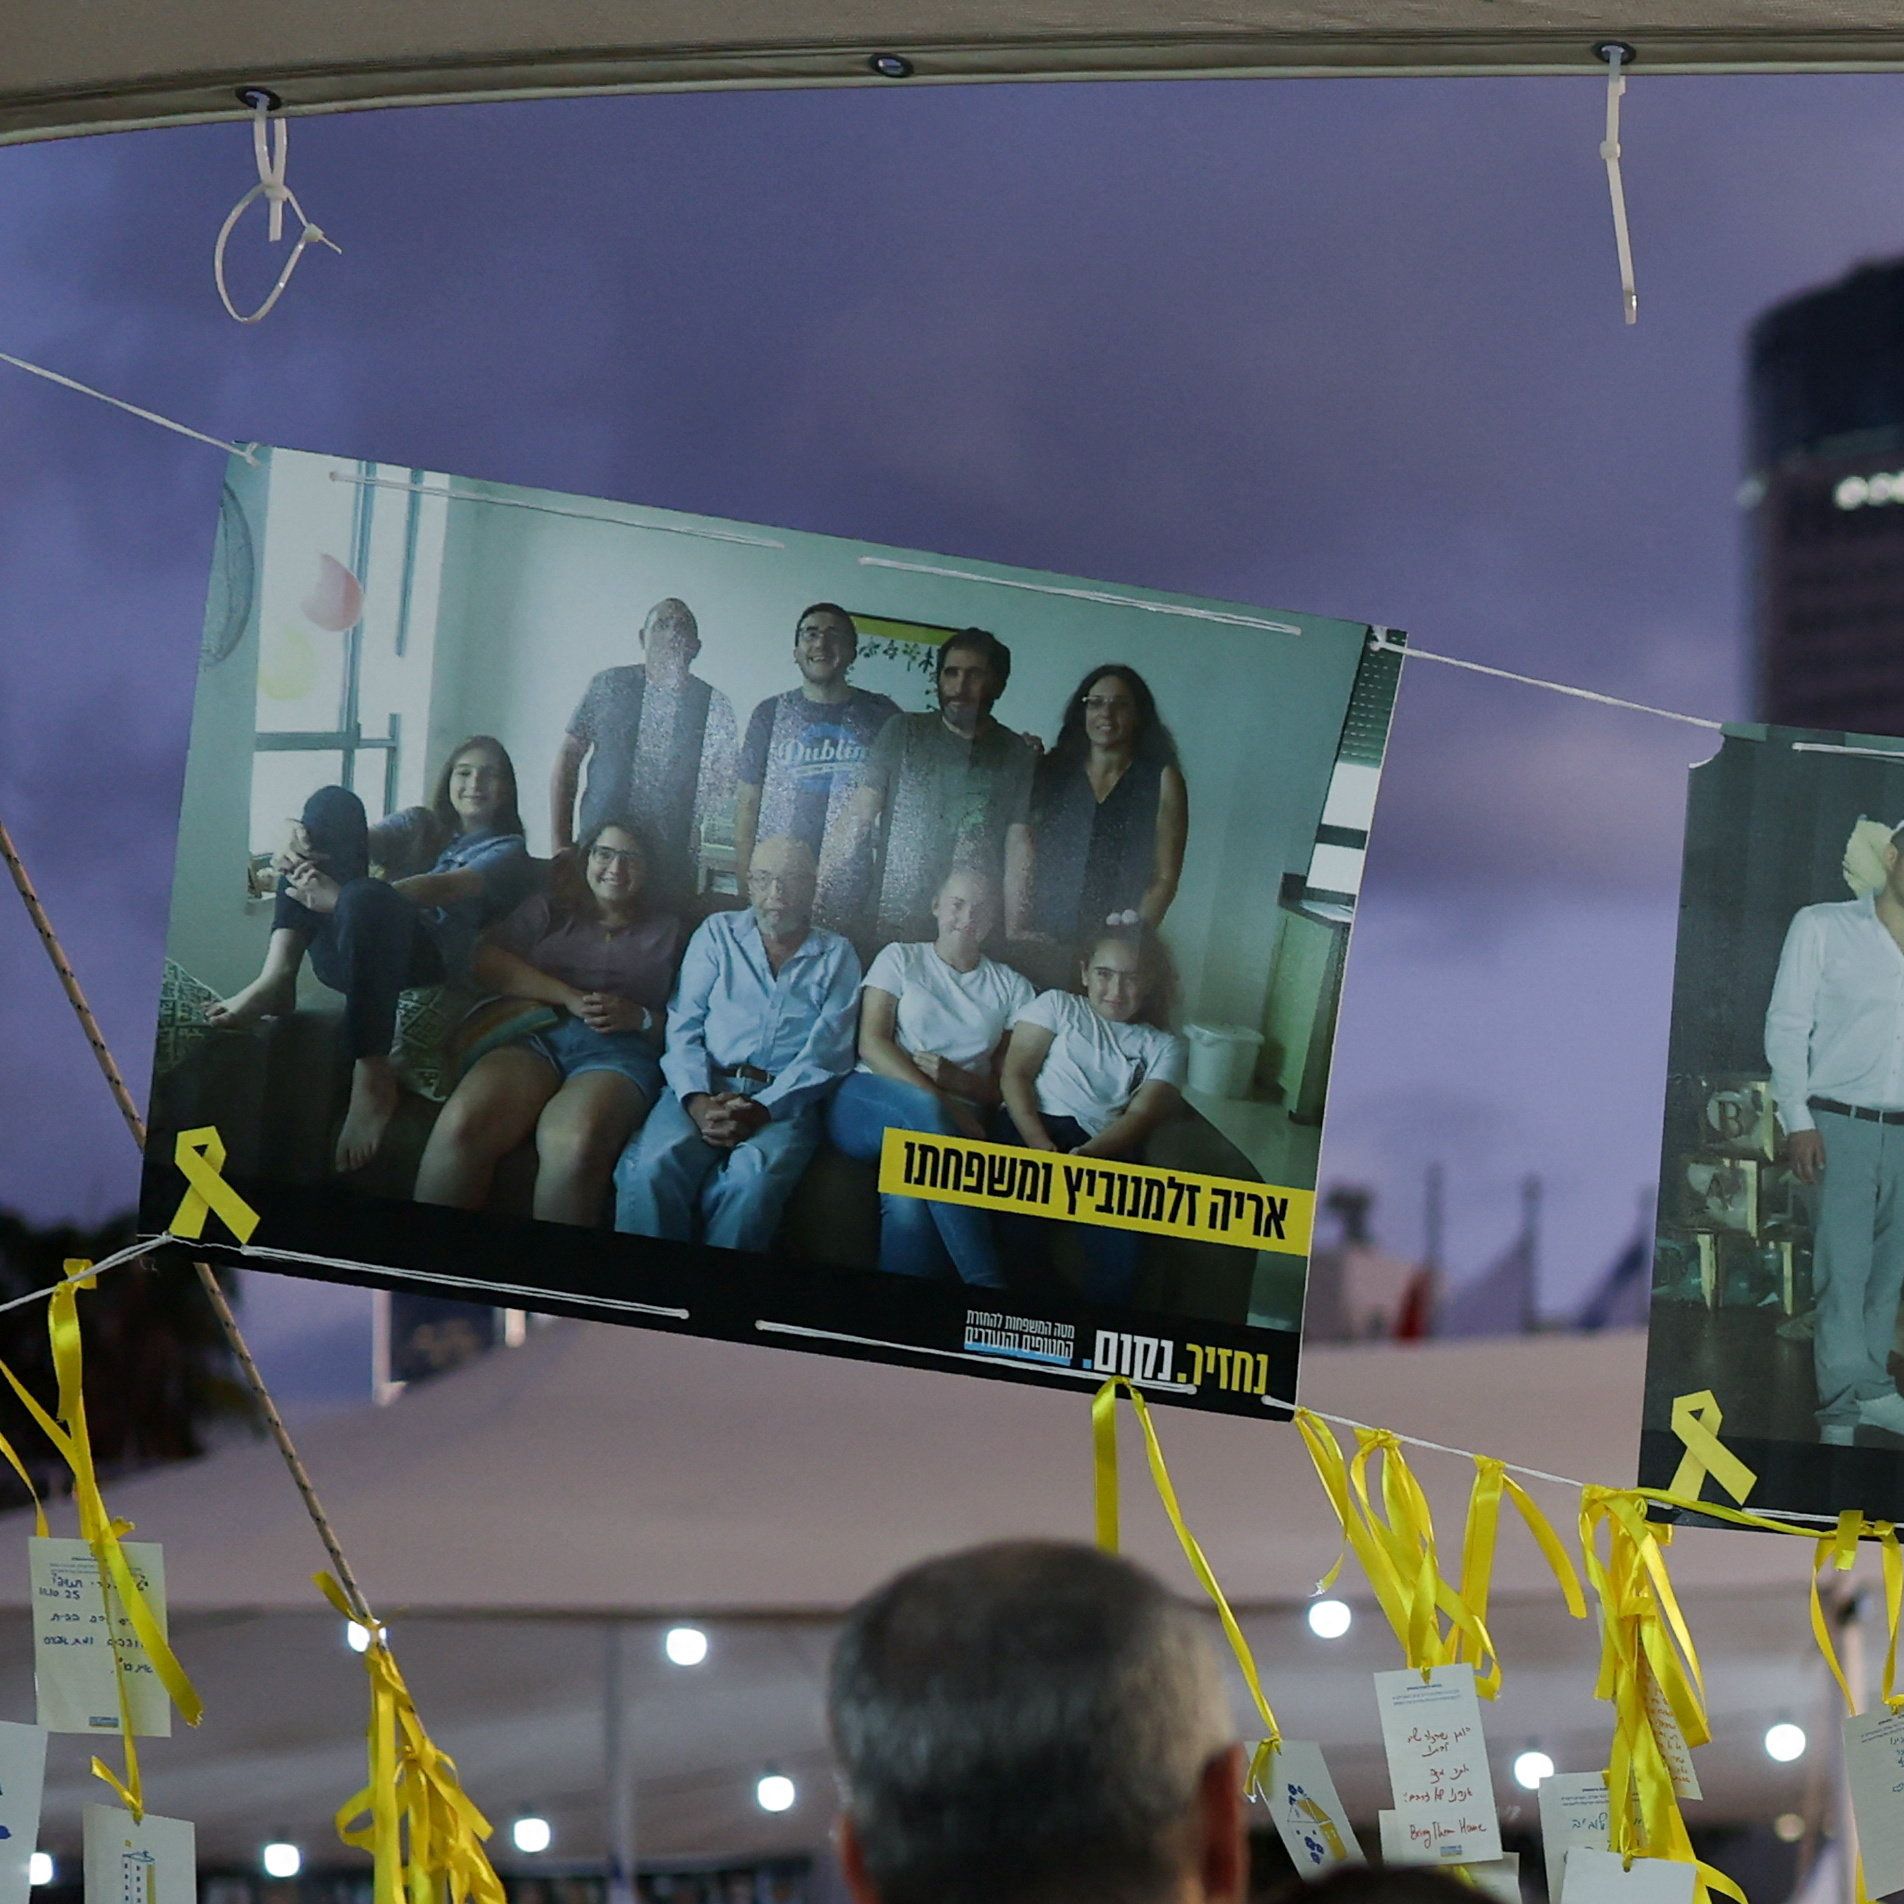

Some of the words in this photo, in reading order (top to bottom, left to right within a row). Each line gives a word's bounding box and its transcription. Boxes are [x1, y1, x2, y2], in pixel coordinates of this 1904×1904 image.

[904, 1141, 1052, 1204] ומשפחתו
[1063, 1165, 1201, 1226] זלמנוביץ
[1209, 1189, 1288, 1240] אריה
[966, 1309, 1003, 1330] להחזרת
[1005, 1315, 1052, 1337] המשפחות
[1053, 1322, 1075, 1339] מטה
[964, 1326, 1019, 1352] והנעדרים
[1021, 1333, 1073, 1360] החטופים
[1082, 1330, 1174, 1381] נקום.
[1177, 1343, 1269, 1395] נחזיר.
[1409, 1824, 1432, 1849] Bring
[1432, 1821, 1456, 1841] Them
[1459, 1818, 1487, 1834] Home
